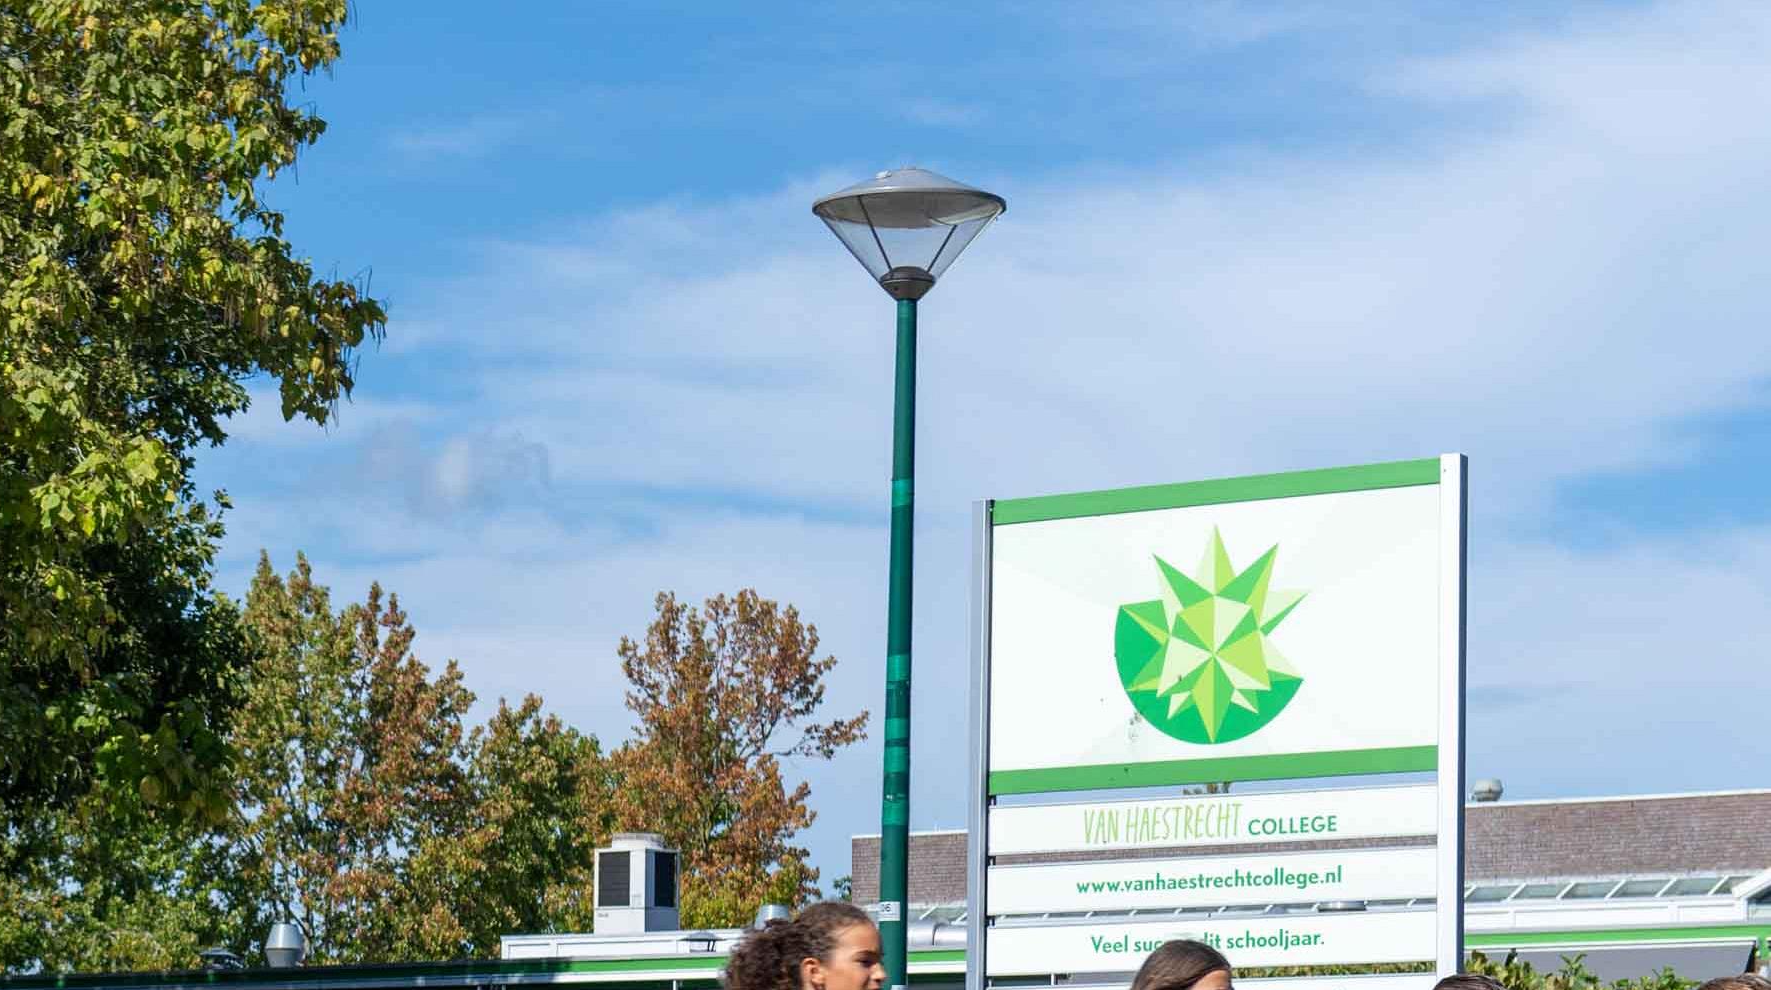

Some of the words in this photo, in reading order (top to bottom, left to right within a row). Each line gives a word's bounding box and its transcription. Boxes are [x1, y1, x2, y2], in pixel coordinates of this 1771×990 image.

[1084, 808, 1119, 844] VAN
[1126, 803, 1243, 843] HAESTRECHT
[1248, 815, 1338, 836] COLLEGE
[1076, 865, 1342, 893] www.vanhaestrechtcollege.nl
[1091, 934, 1128, 954] Veel
[1227, 928, 1325, 952] schooljaar.
